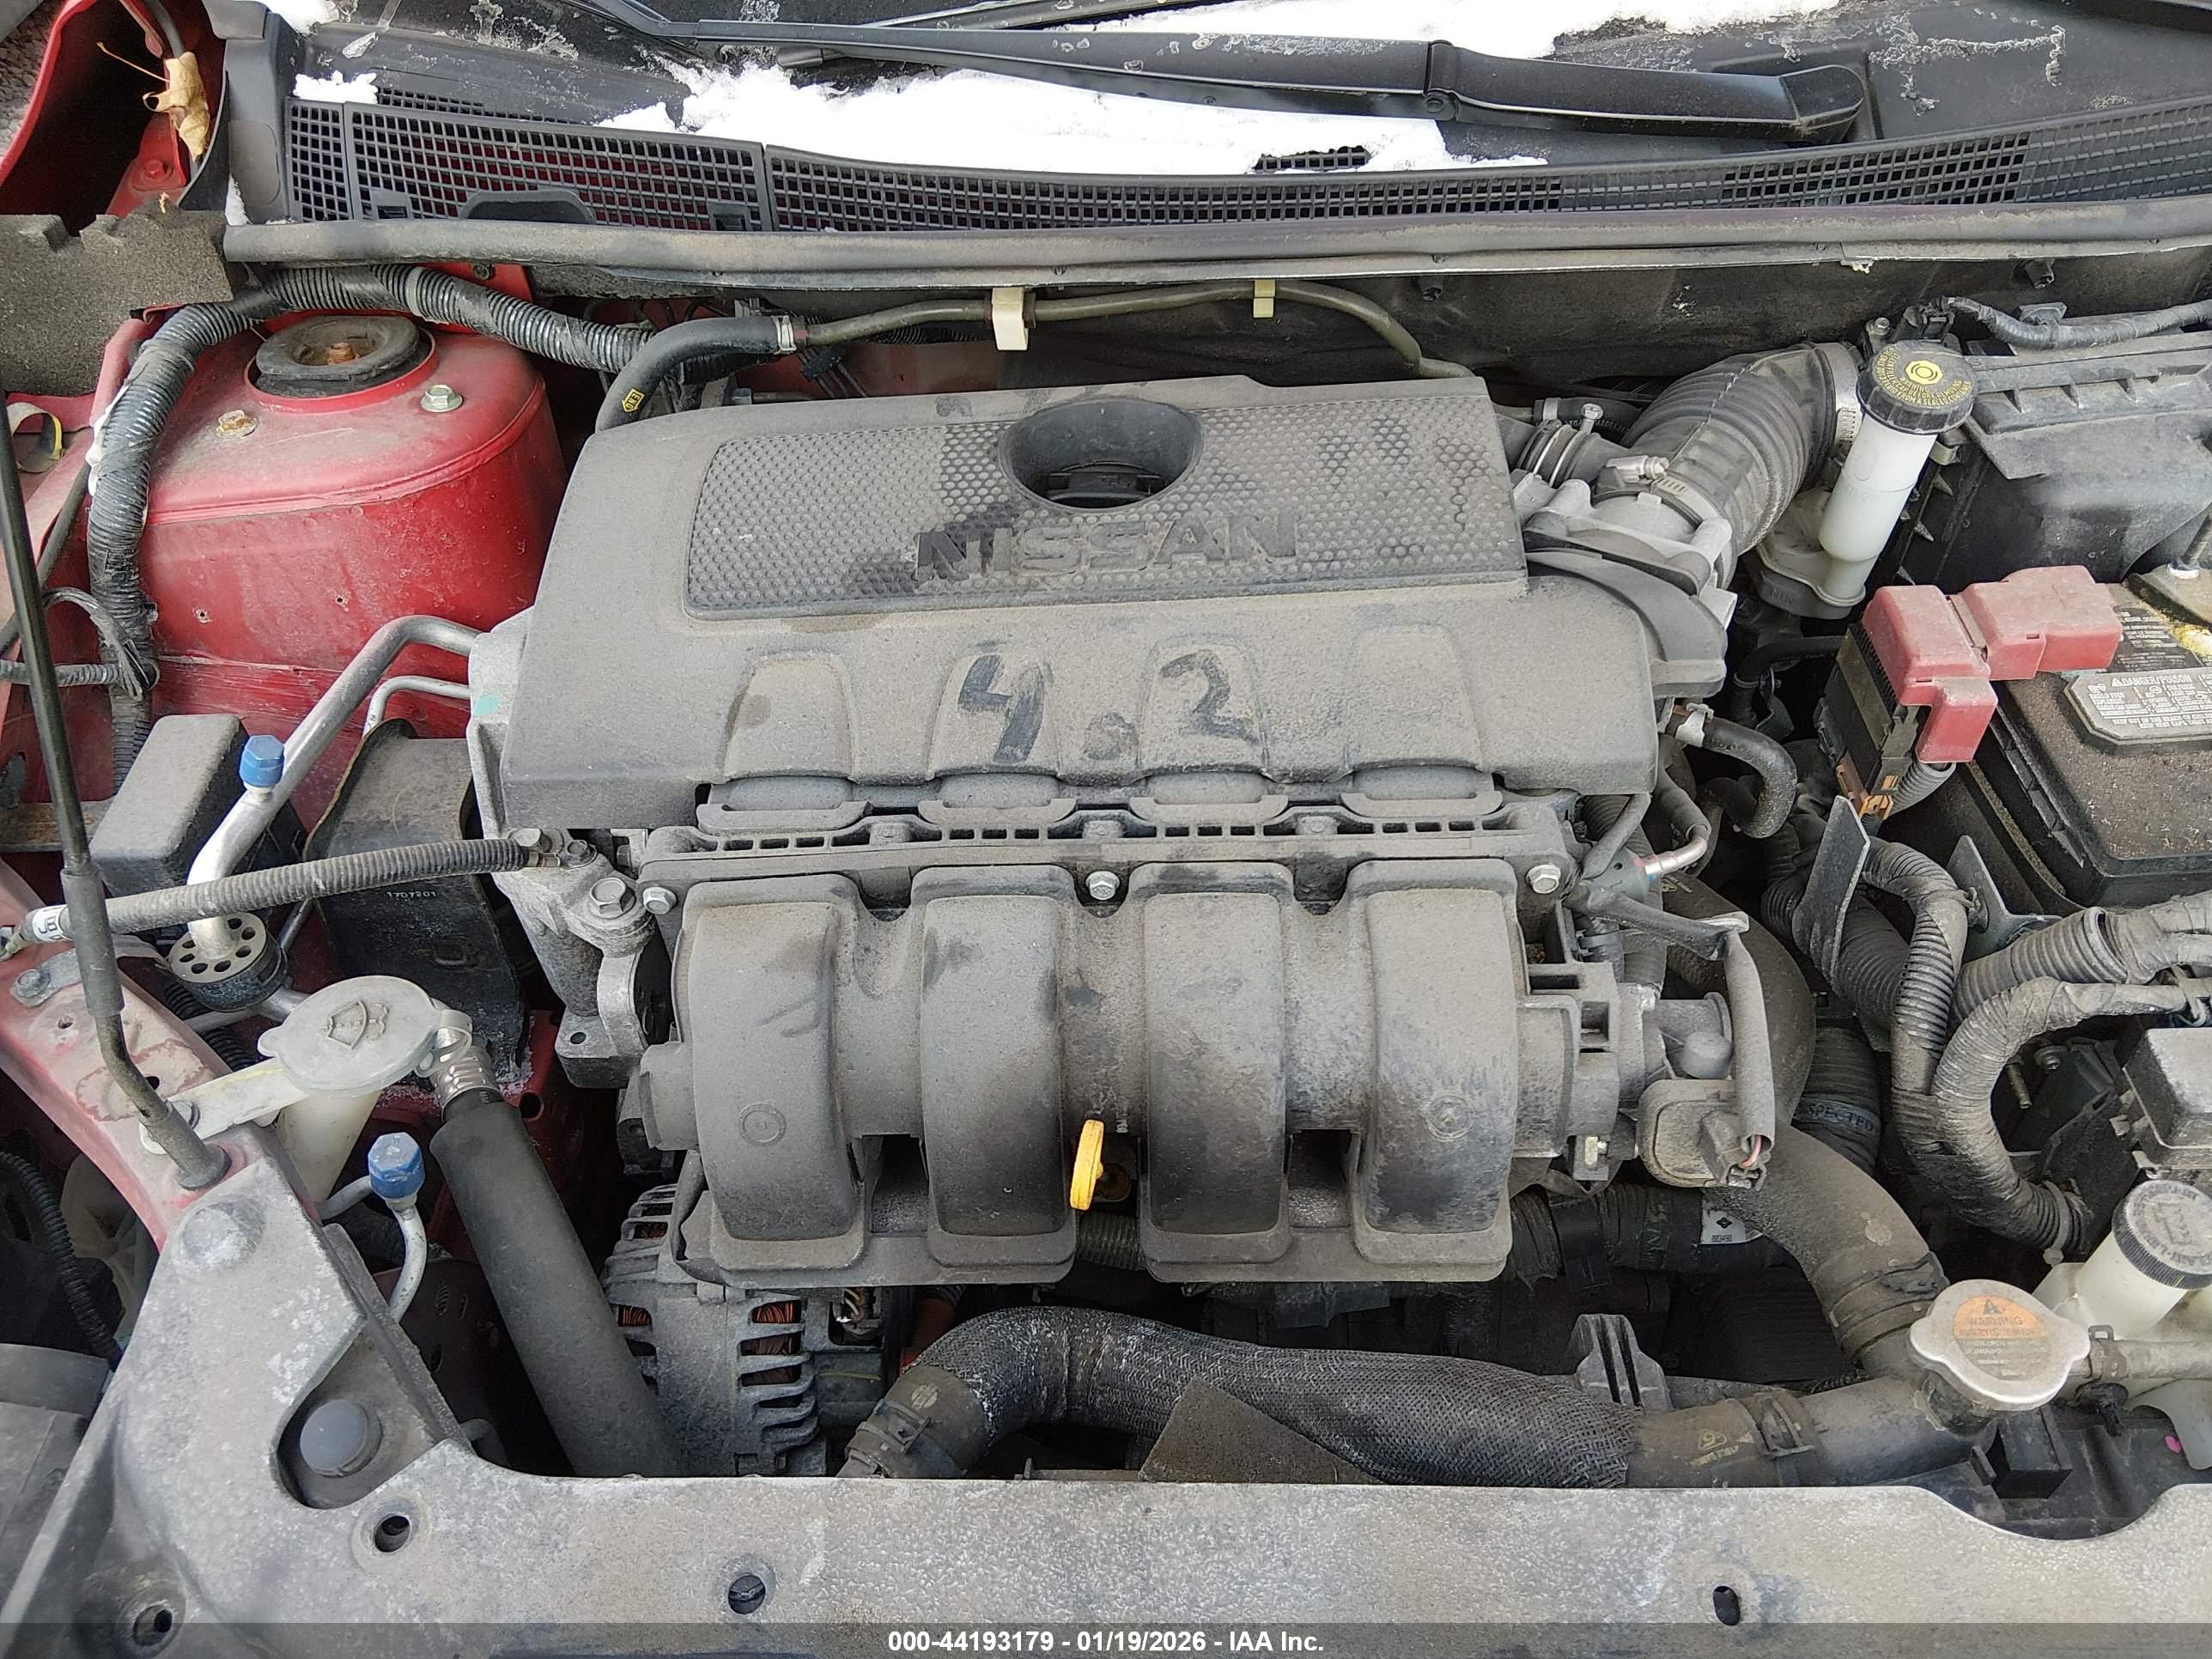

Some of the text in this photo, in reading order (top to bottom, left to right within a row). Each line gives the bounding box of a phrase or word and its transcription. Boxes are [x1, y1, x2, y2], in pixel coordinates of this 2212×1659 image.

[1896, 381, 1909, 393] CAP
[1907, 388, 1936, 398] BEFORE
[1899, 377, 1929, 393] WARNING
[1896, 391, 1917, 403] FROM
[1923, 396, 1948, 406] SEALED
[915, 516, 1297, 582] NISSAN
